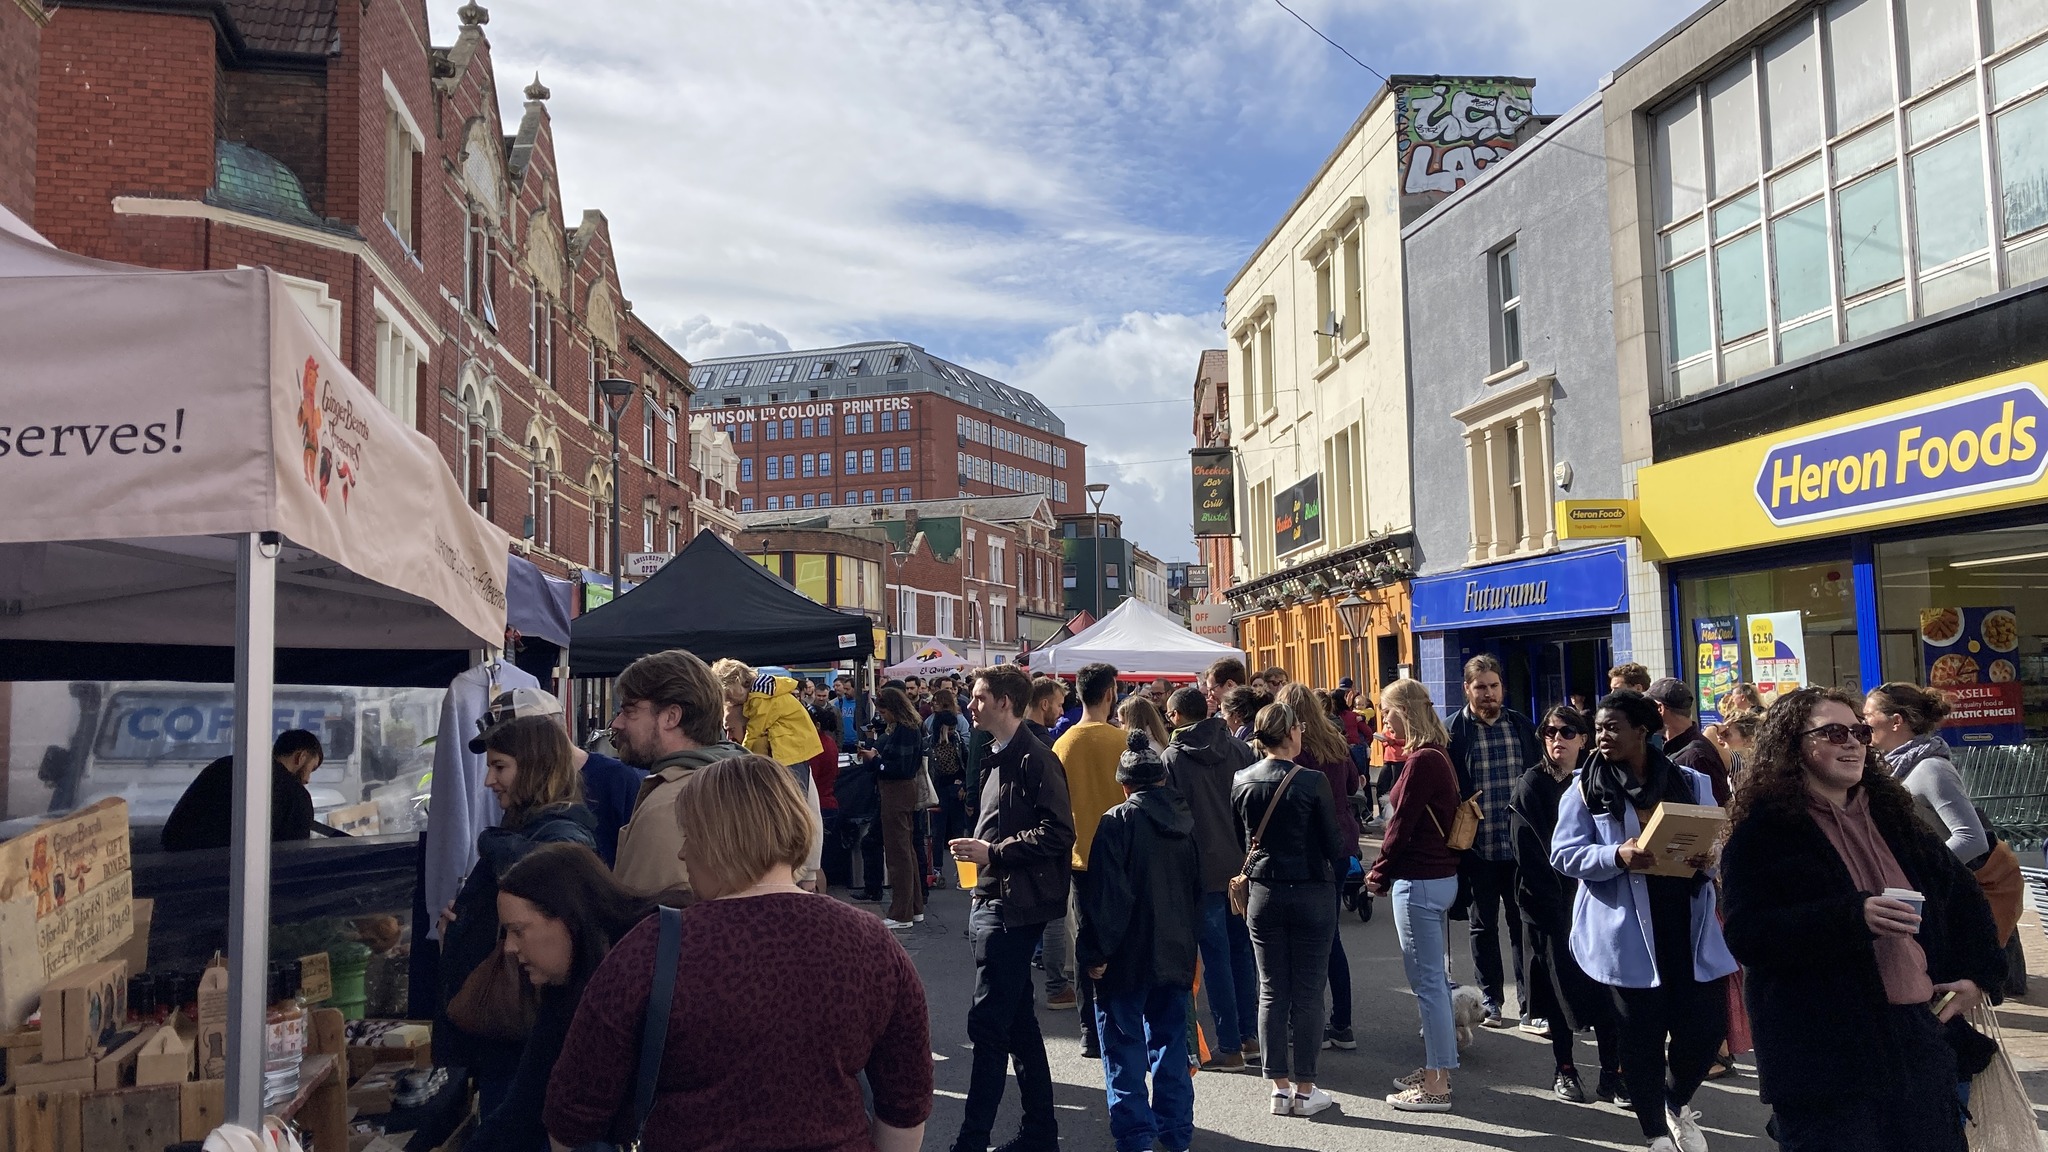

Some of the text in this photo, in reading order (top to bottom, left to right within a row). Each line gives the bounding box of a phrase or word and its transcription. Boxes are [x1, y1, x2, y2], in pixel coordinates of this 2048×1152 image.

[779, 403, 834, 420] COLOUR
[1771, 400, 2037, 508] Heron Foods
[1193, 466, 1232, 476] Cheekies
[1203, 478, 1224, 486] Bar
[1210, 489, 1218, 498] &
[1203, 499, 1224, 508] Grill
[1201, 512, 1228, 522] Bristol
[1572, 510, 1622, 518] Heron Foods
[633, 555, 665, 566] AMUSEMENTS
[642, 566, 658, 574] OPEN
[1464, 580, 1548, 613] Futurama
[1195, 612, 1208, 621] OFF
[1195, 624, 1226, 634] LICENCE
[1702, 626, 1734, 641] Meal Deal
[1753, 632, 1773, 644] £2.50
[1700, 654, 1712, 670] £4
[1963, 701, 1982, 709] quality
[1984, 708, 2016, 717] PRICES!
[106, 836, 123, 857] GIFT
